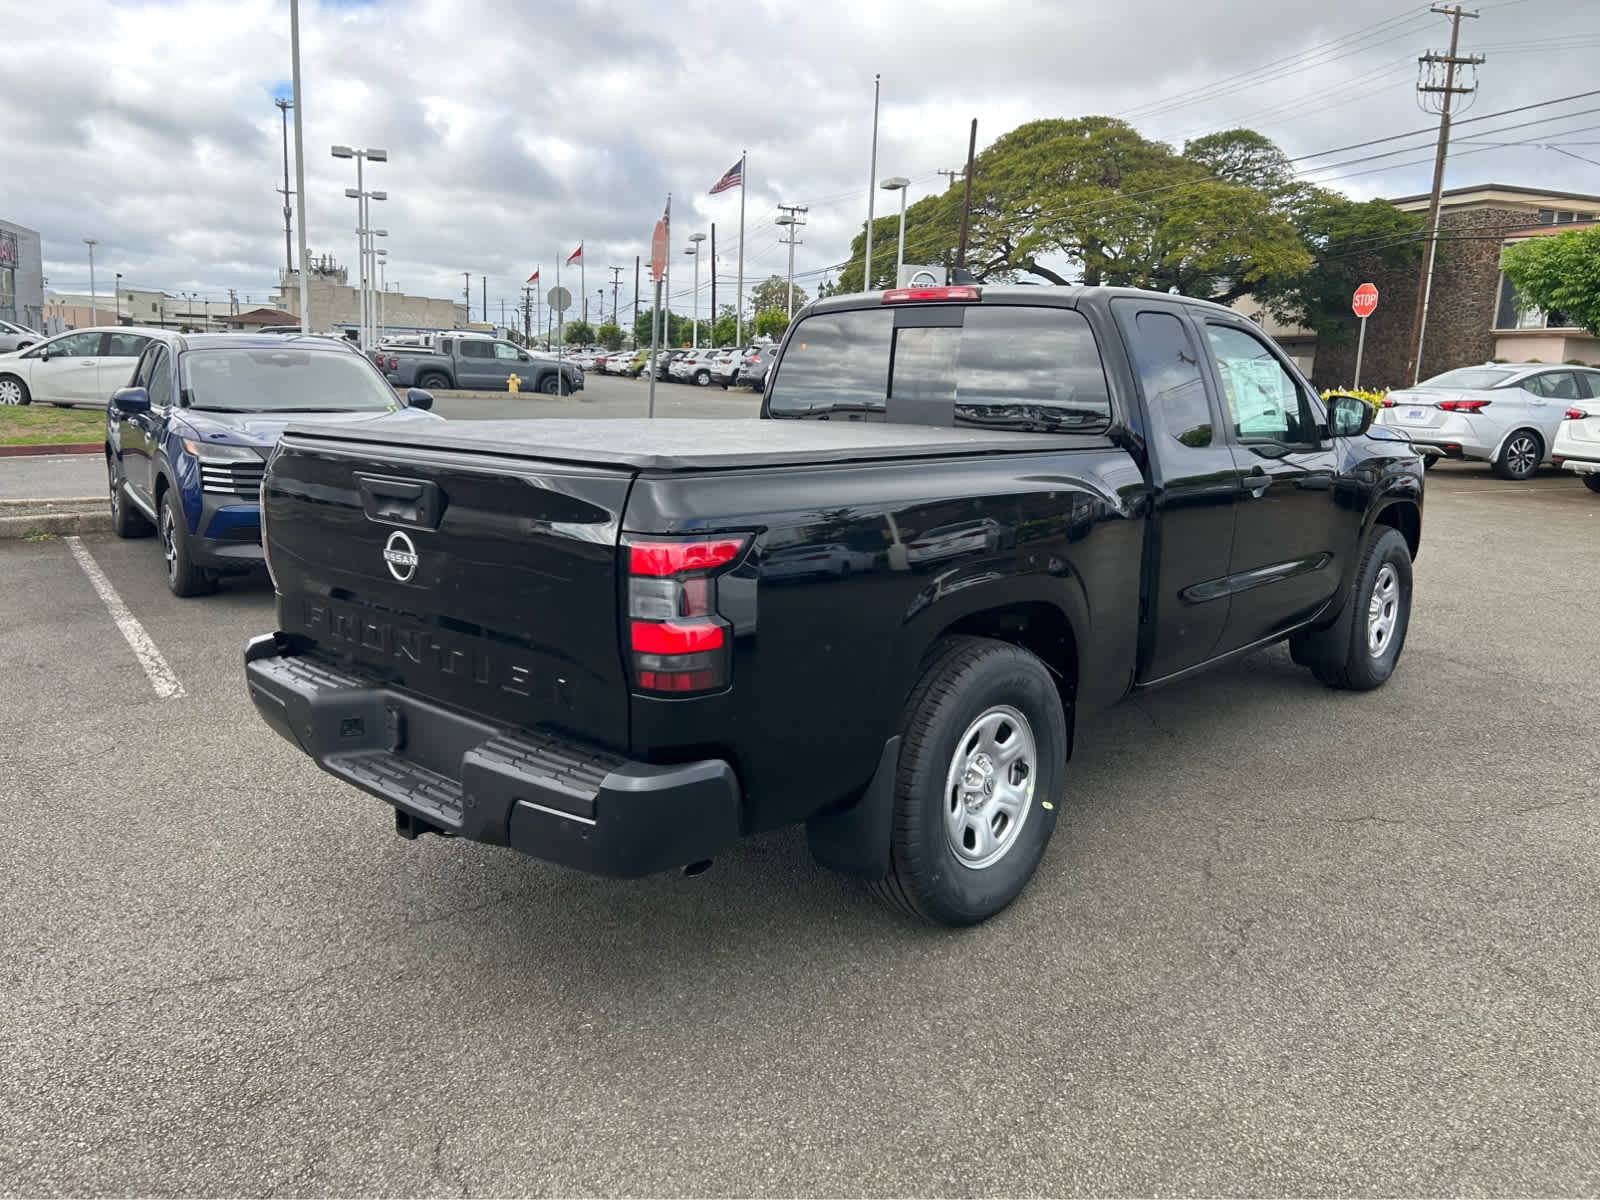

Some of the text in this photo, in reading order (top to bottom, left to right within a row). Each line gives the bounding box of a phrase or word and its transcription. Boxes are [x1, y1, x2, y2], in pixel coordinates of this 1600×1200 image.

[1354, 294, 1377, 307] STOP
[384, 550, 417, 566] NISSAN
[303, 600, 577, 711] FRONTIER
